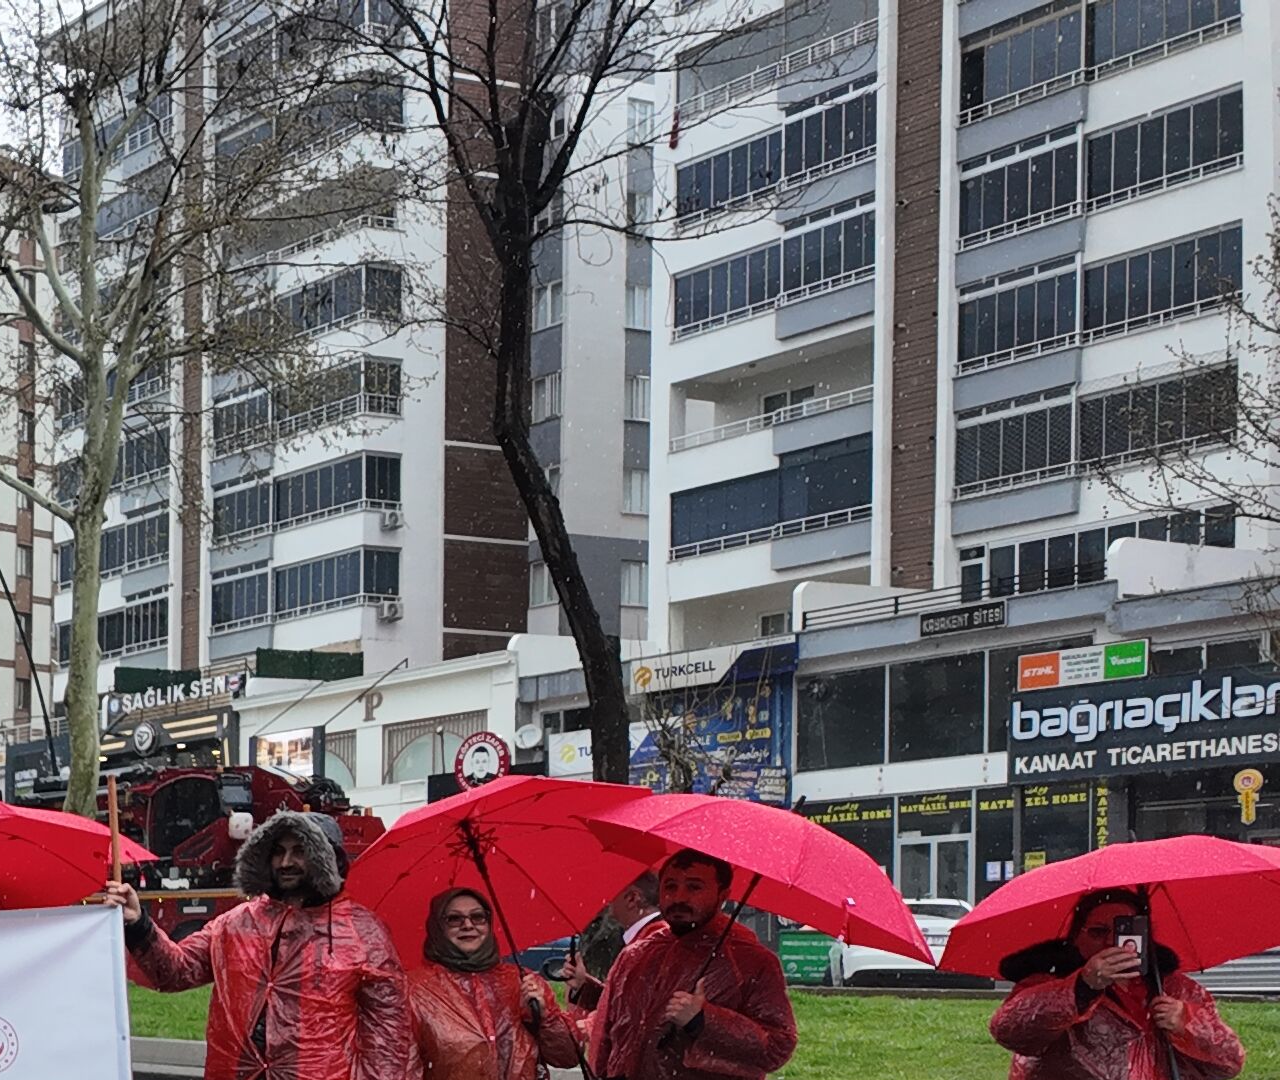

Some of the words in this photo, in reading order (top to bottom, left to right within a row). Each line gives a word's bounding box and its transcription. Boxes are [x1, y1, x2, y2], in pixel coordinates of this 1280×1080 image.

[654, 660, 716, 680] TURKCELL
[1022, 665, 1055, 678] STIHL
[122, 684, 186, 714] SAĞLIK
[190, 676, 226, 699] SEN
[1014, 750, 1097, 775] KANAAT
[806, 812, 860, 823] ATMAZEL
[1097, 787, 1109, 848] MATMAZ
